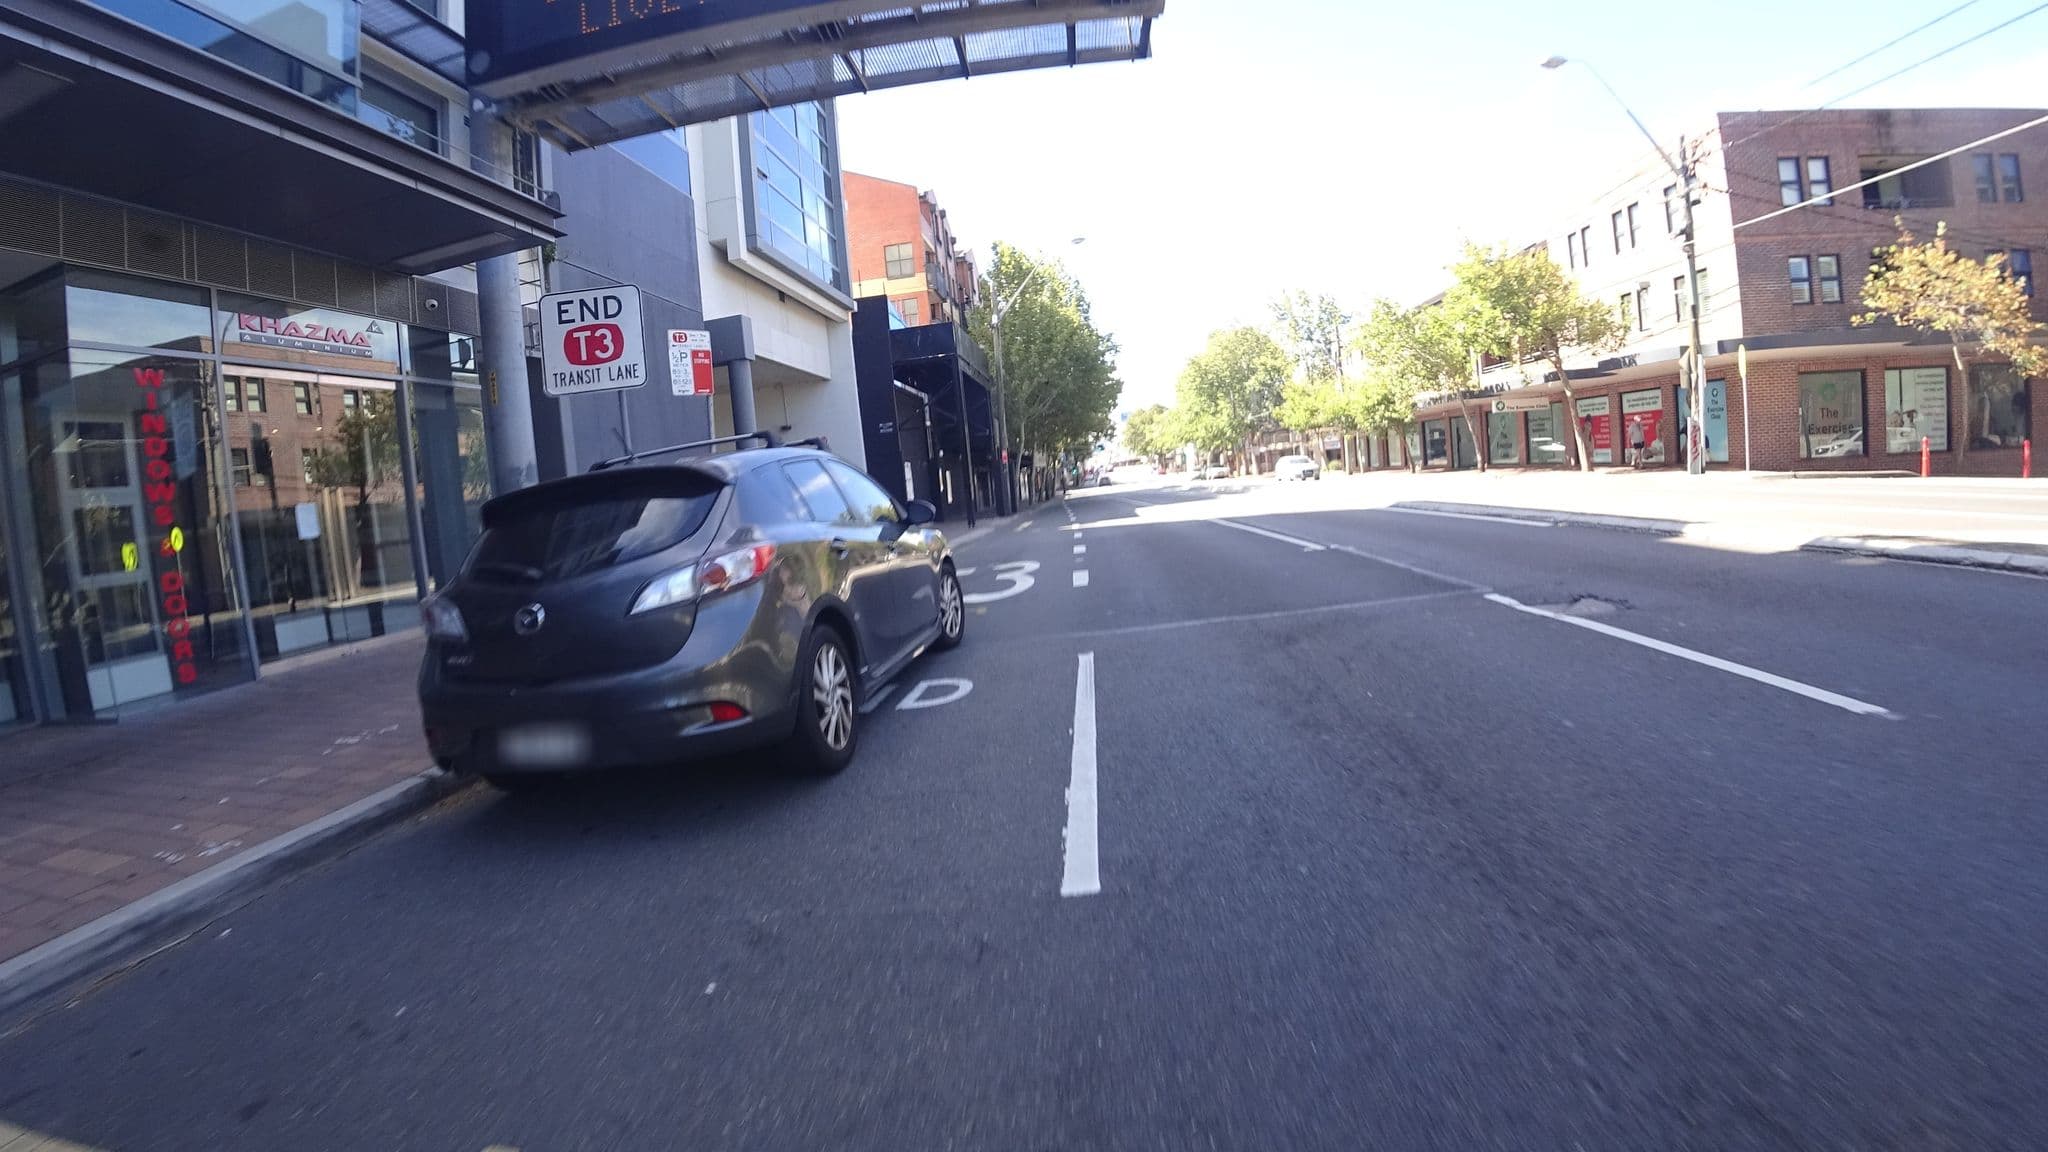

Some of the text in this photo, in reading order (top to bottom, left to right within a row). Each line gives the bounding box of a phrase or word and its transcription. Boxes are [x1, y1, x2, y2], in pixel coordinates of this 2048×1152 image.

[557, 295, 623, 325] END
[239, 313, 371, 347] KHAZMA
[243, 334, 373, 356] ALUMINIUM
[573, 328, 615, 361] T3
[553, 364, 640, 388] TRANSIT LANE
[1819, 407, 1839, 419] The
[1808, 423, 1854, 436] Exercise
[133, 368, 176, 525] WINDOWS
[160, 571, 198, 684] DOORS
